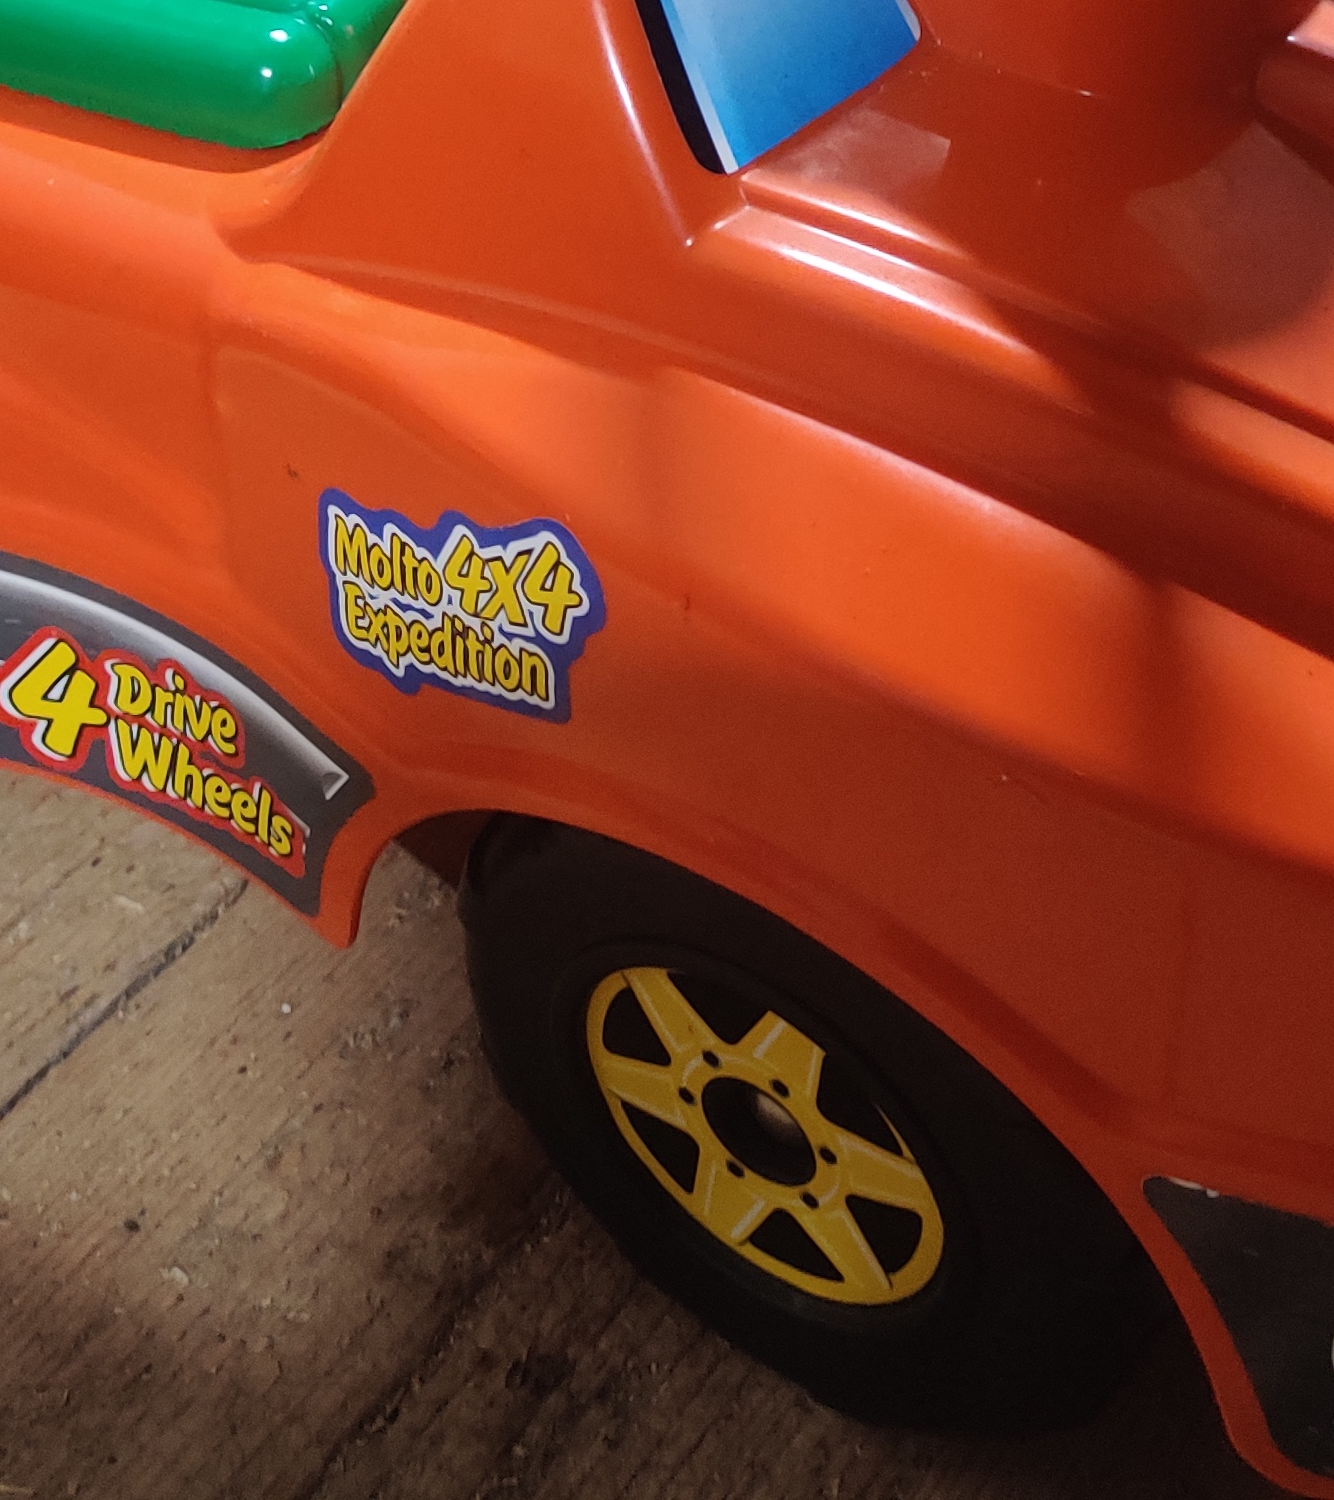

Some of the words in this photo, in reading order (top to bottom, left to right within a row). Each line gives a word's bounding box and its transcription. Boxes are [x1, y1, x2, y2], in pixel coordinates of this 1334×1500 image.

[334, 513, 443, 607] Molto
[5, 638, 108, 758] 4
[342, 580, 550, 702] Expedition
[110, 662, 238, 756] Drive
[111, 715, 295, 857] Wheels
